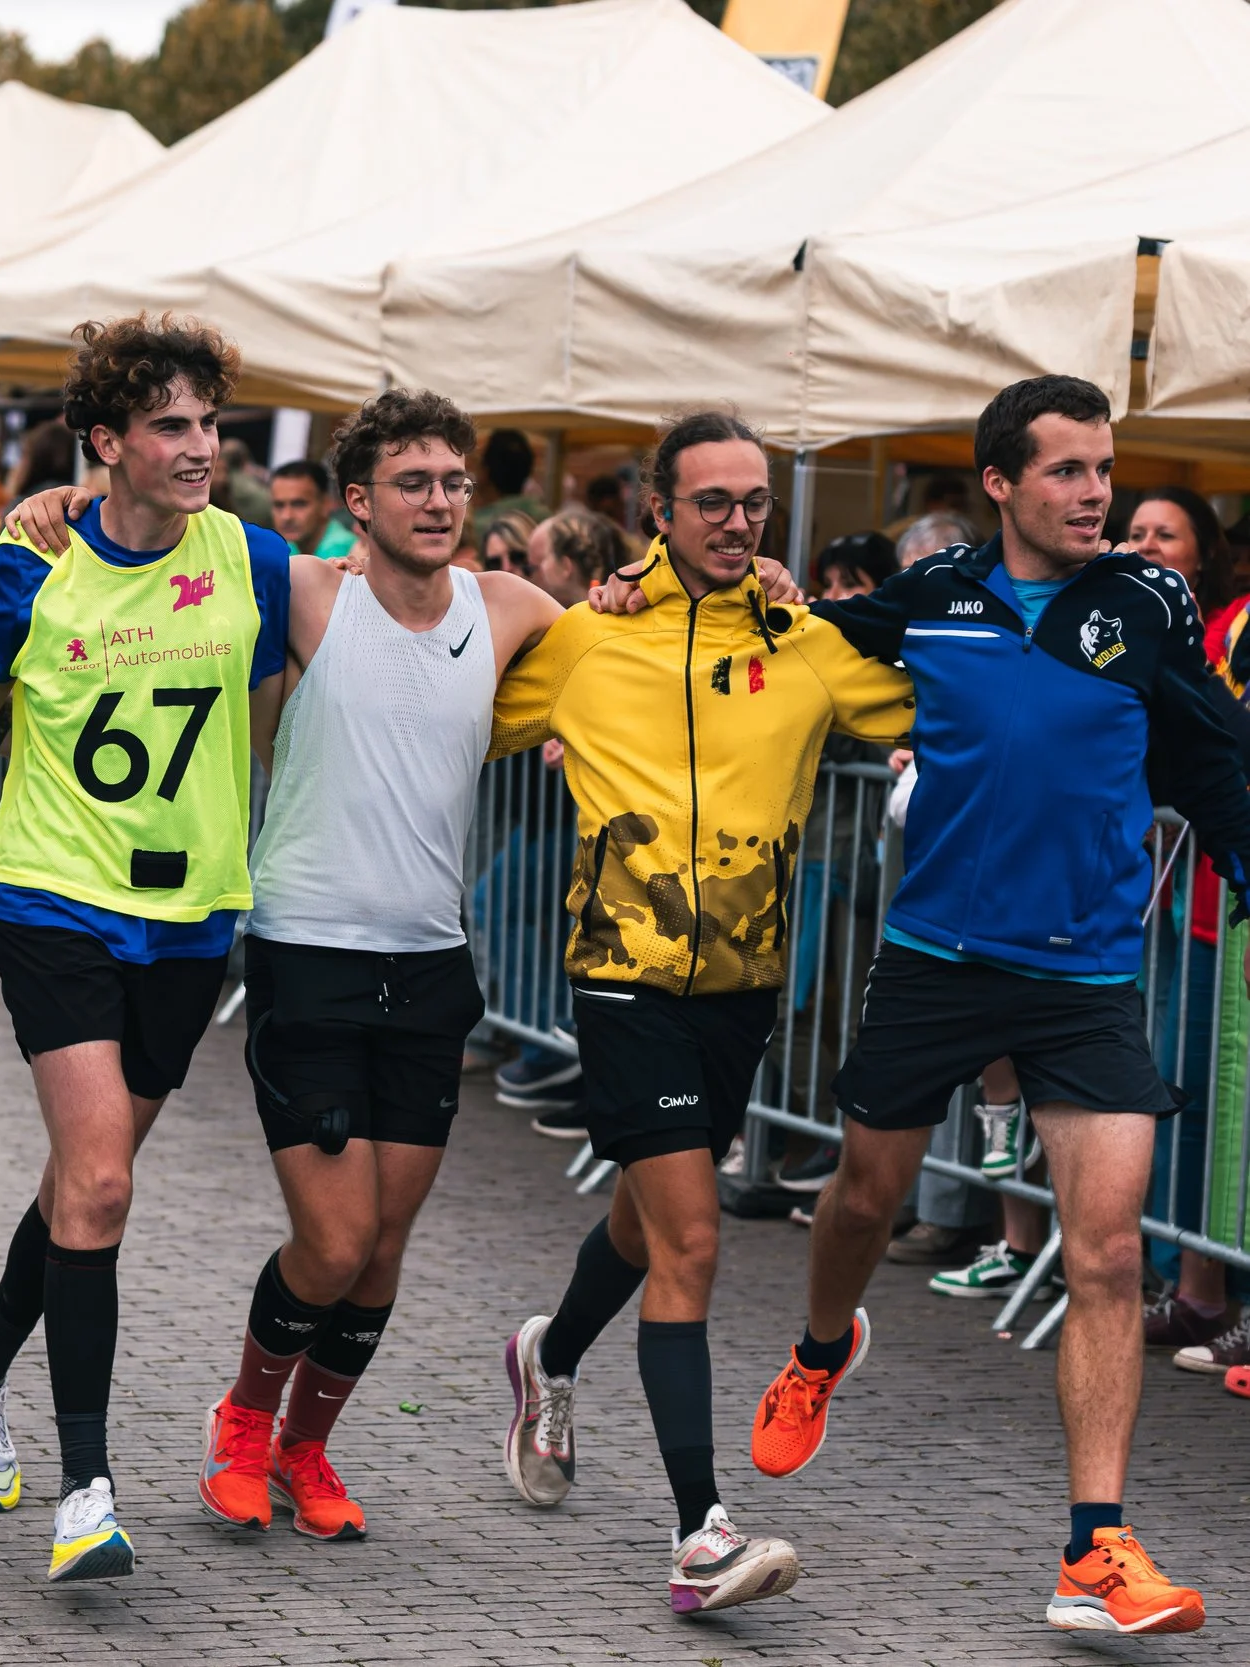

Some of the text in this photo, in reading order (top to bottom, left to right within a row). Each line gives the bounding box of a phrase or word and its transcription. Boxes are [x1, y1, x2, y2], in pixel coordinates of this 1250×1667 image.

[947, 600, 984, 615] JAKO
[110, 626, 154, 646] ATH
[113, 640, 232, 669] Automobiles
[1092, 642, 1126, 668] WOLVES
[58, 661, 102, 672] PEUGEOT
[73, 686, 223, 803] 67
[658, 1094, 699, 1108] CIMALP
